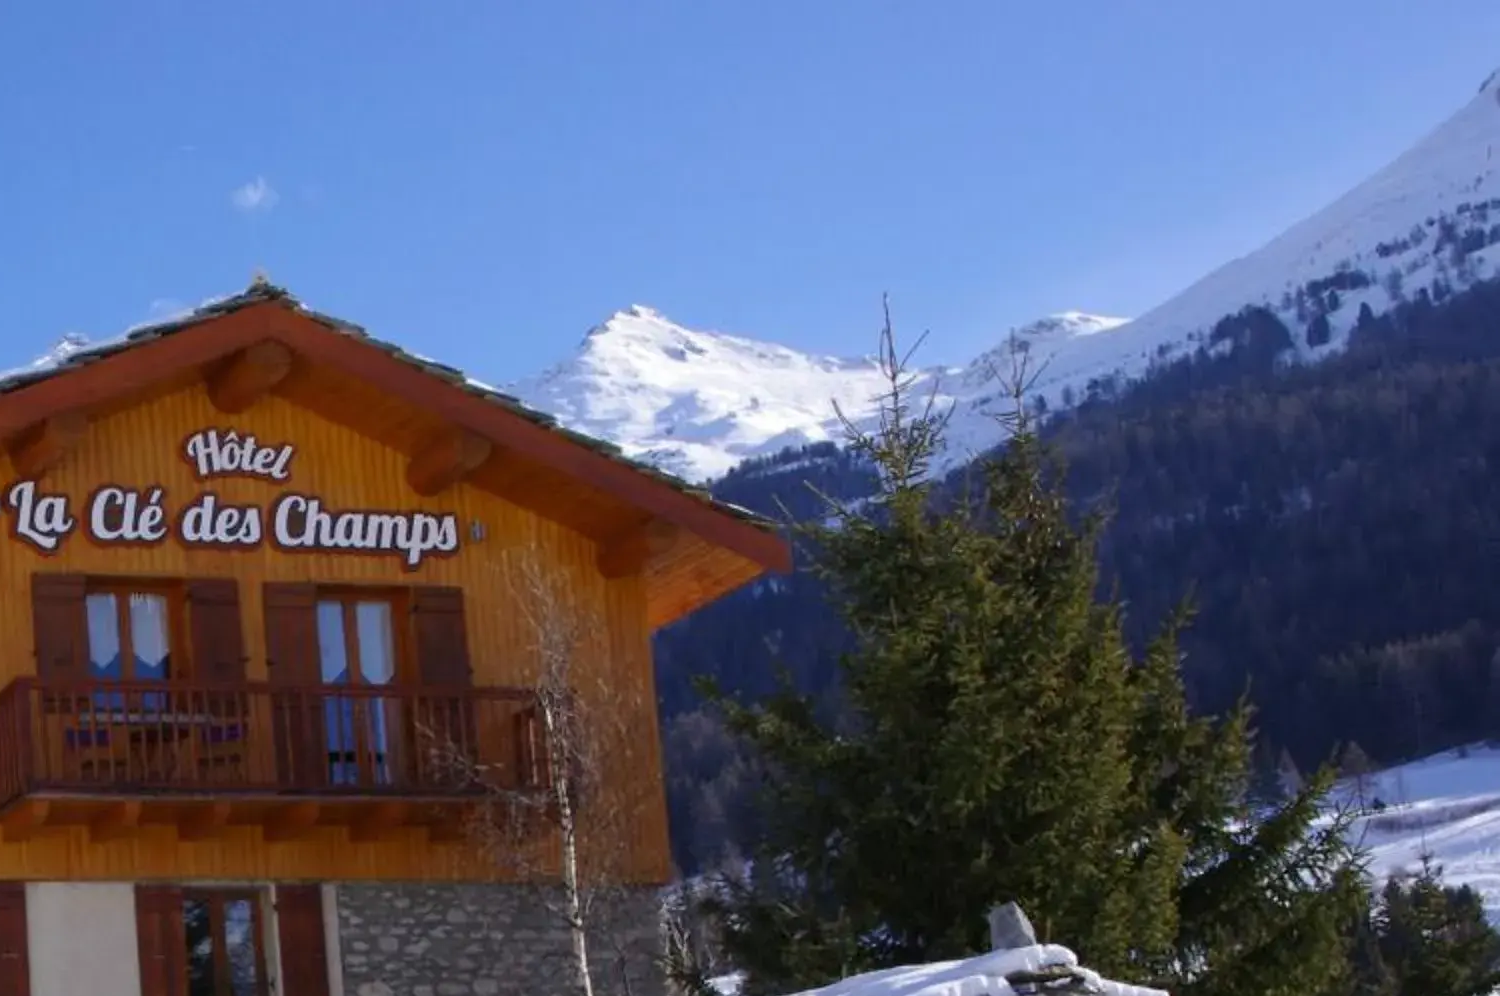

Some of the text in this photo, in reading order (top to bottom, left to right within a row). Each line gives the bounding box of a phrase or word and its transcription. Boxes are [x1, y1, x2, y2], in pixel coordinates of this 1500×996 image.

[187, 429, 293, 479] Hôtel
[8, 481, 458, 565] La Clé des Champs
